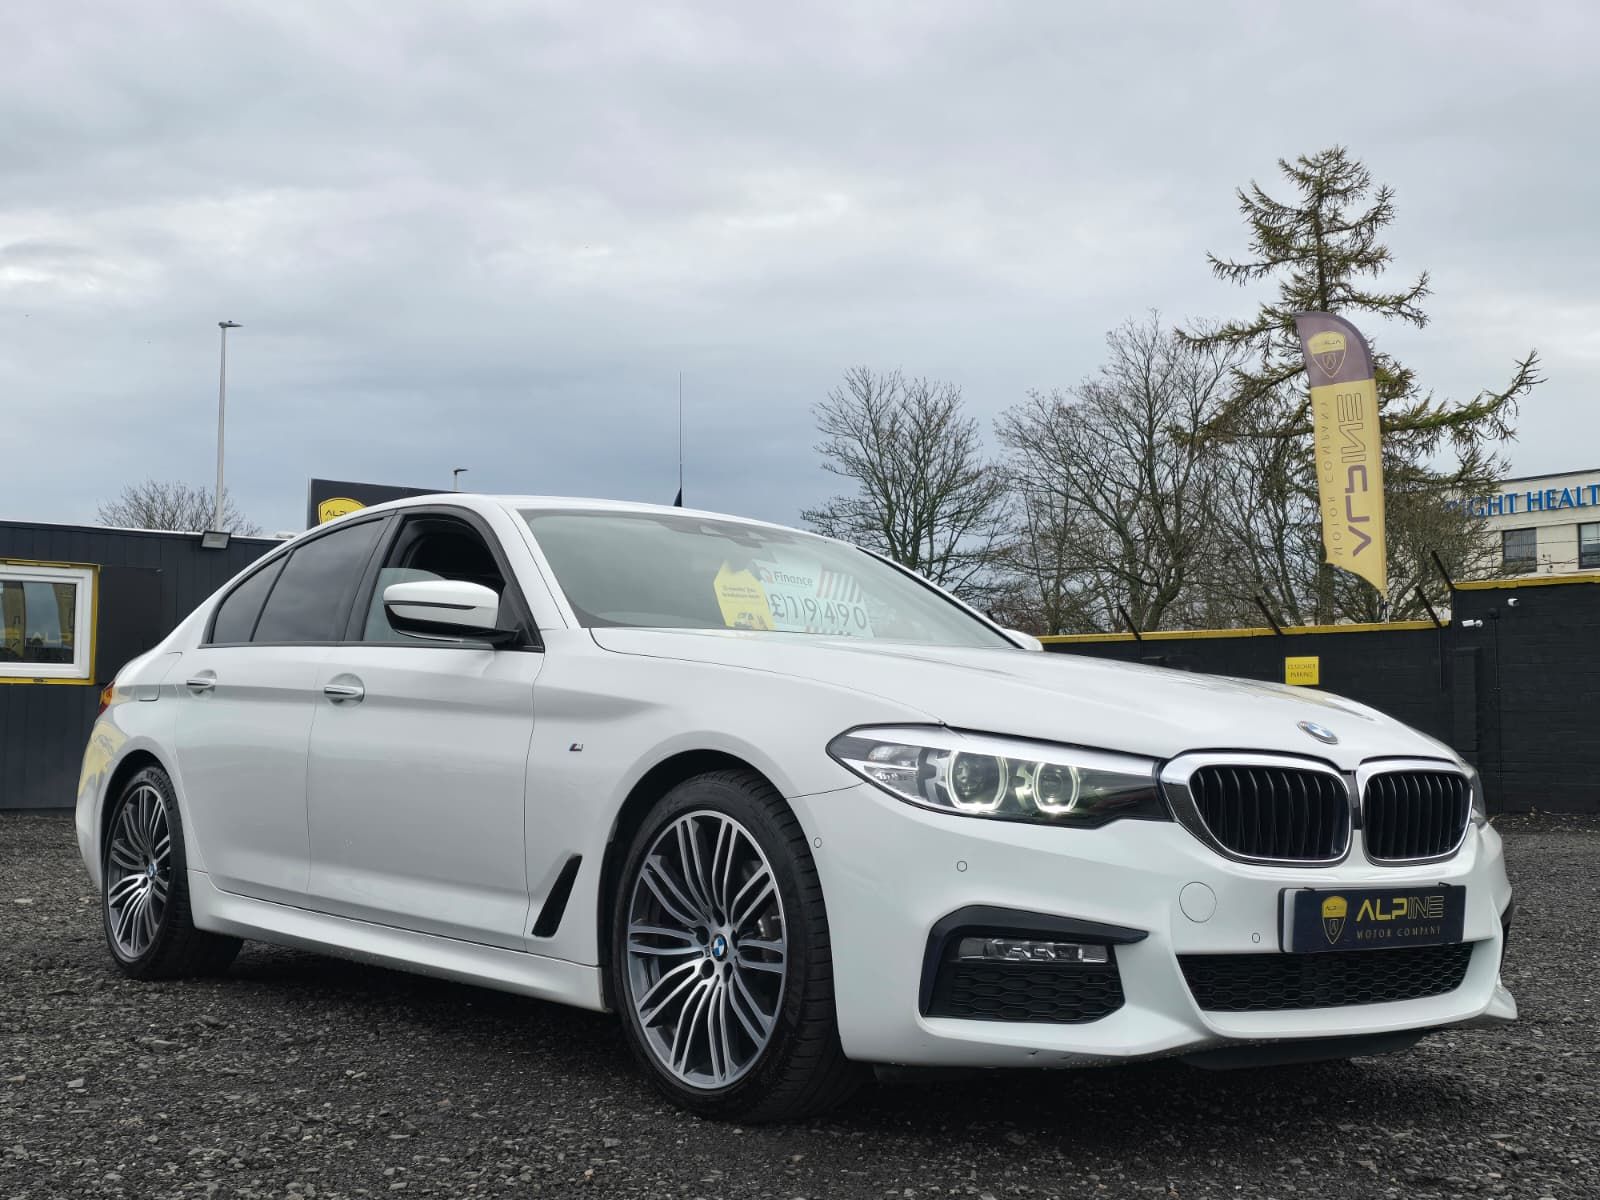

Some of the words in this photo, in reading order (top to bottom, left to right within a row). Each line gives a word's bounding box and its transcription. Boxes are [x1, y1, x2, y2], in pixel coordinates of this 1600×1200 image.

[774, 571, 813, 587] Finance
[1356, 895, 1445, 922] ALPINE
[1356, 929, 1392, 939] MOTOR
[1397, 925, 1441, 936] COMPANY
